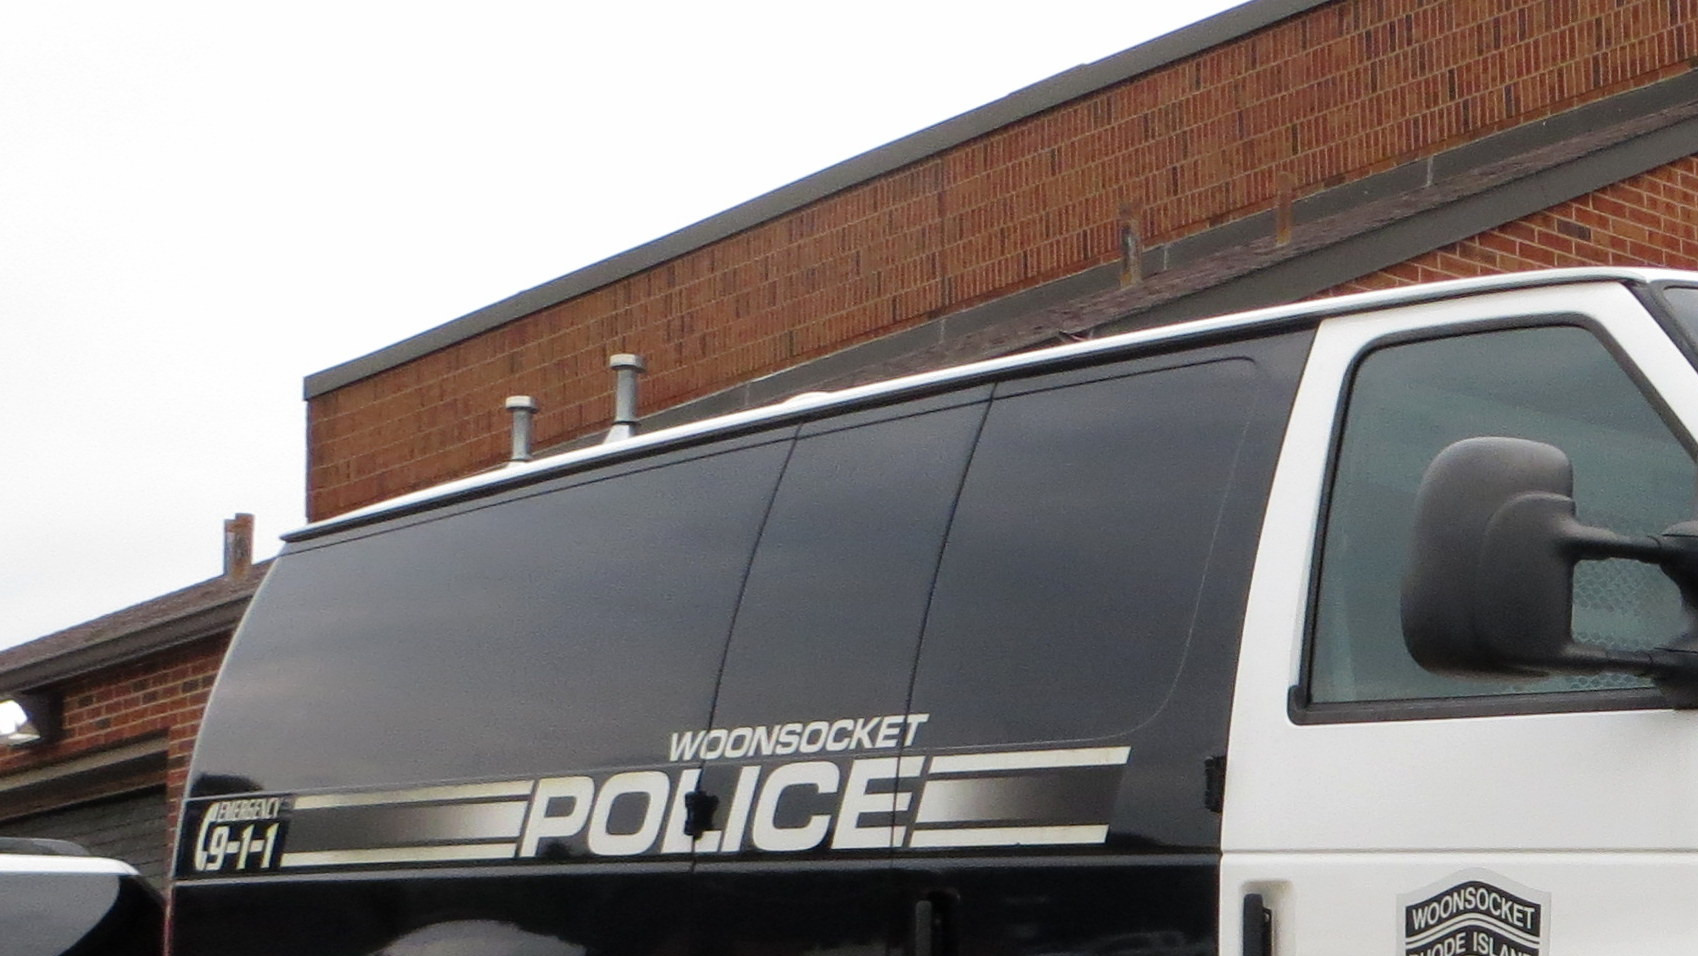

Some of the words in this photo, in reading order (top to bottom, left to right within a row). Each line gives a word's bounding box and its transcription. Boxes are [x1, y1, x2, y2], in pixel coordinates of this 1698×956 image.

[668, 713, 930, 762] WOONSOCKET
[519, 755, 926, 859] POLICE
[204, 822, 279, 871] 9-1-1
[1412, 886, 1536, 930] WOONSOCKET
